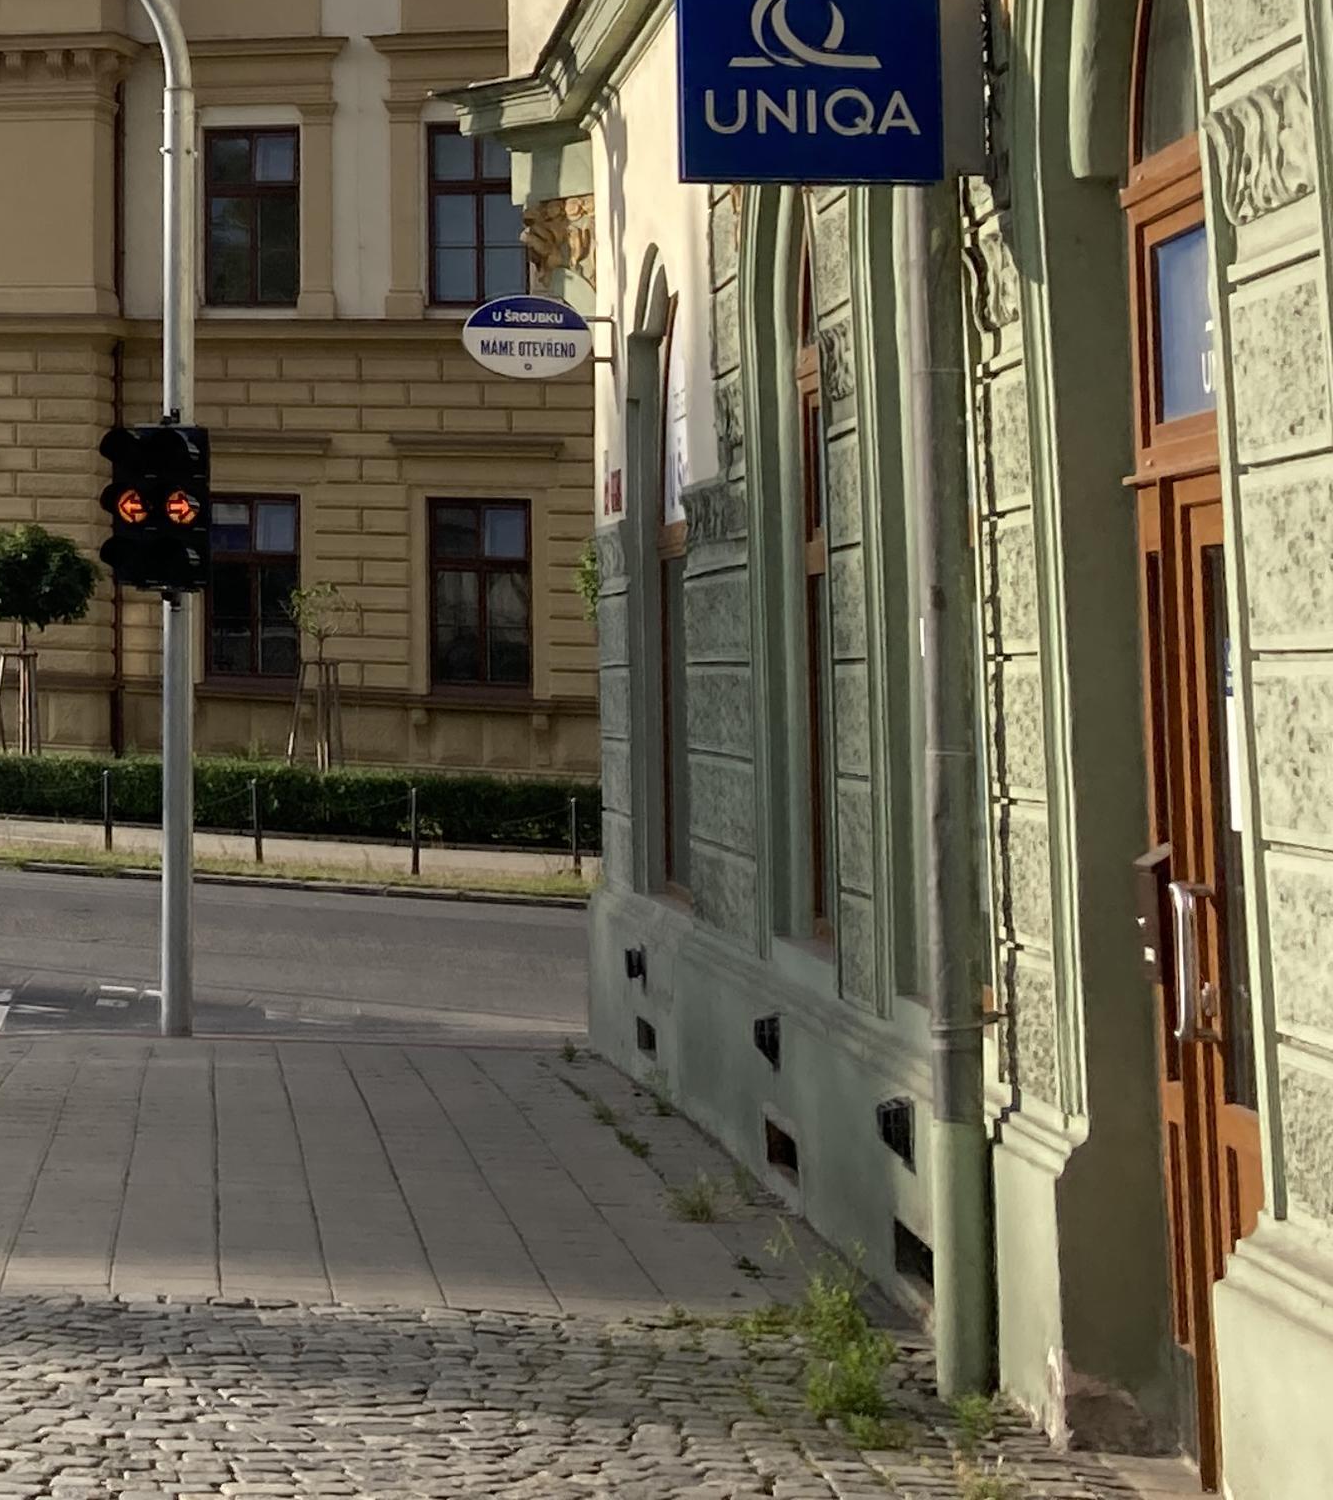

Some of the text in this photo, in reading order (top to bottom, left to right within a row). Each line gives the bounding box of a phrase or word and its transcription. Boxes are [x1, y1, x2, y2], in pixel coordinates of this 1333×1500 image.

[705, 88, 921, 136] UNIQA
[492, 308, 564, 324] U ŠROUBKU
[480, 336, 576, 359] MÁME OTEVŘENO
